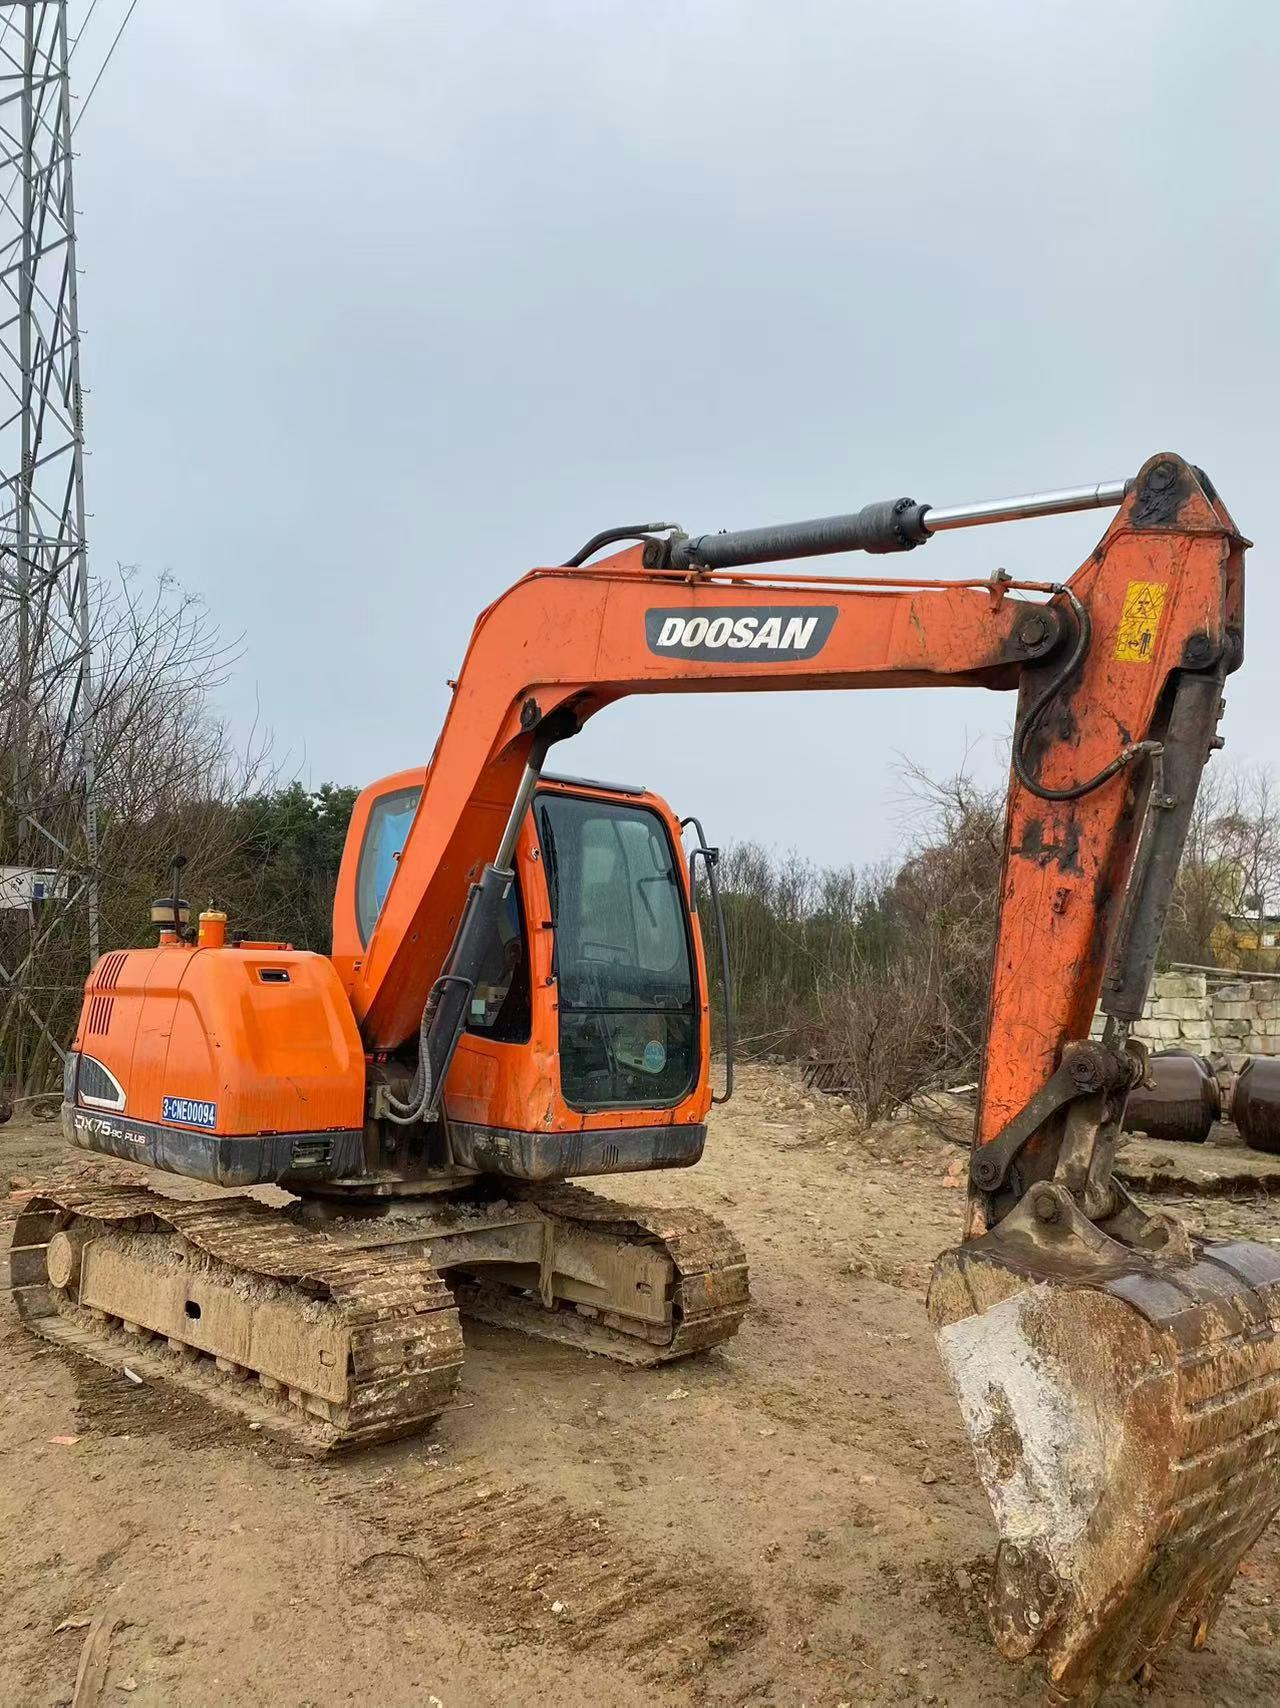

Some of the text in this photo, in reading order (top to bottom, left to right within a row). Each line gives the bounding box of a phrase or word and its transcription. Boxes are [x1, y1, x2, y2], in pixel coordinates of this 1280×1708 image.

[656, 616, 819, 649] DOOSAN
[163, 1098, 215, 1125] 3-CNE00094
[124, 1132, 146, 1144] PLUS
